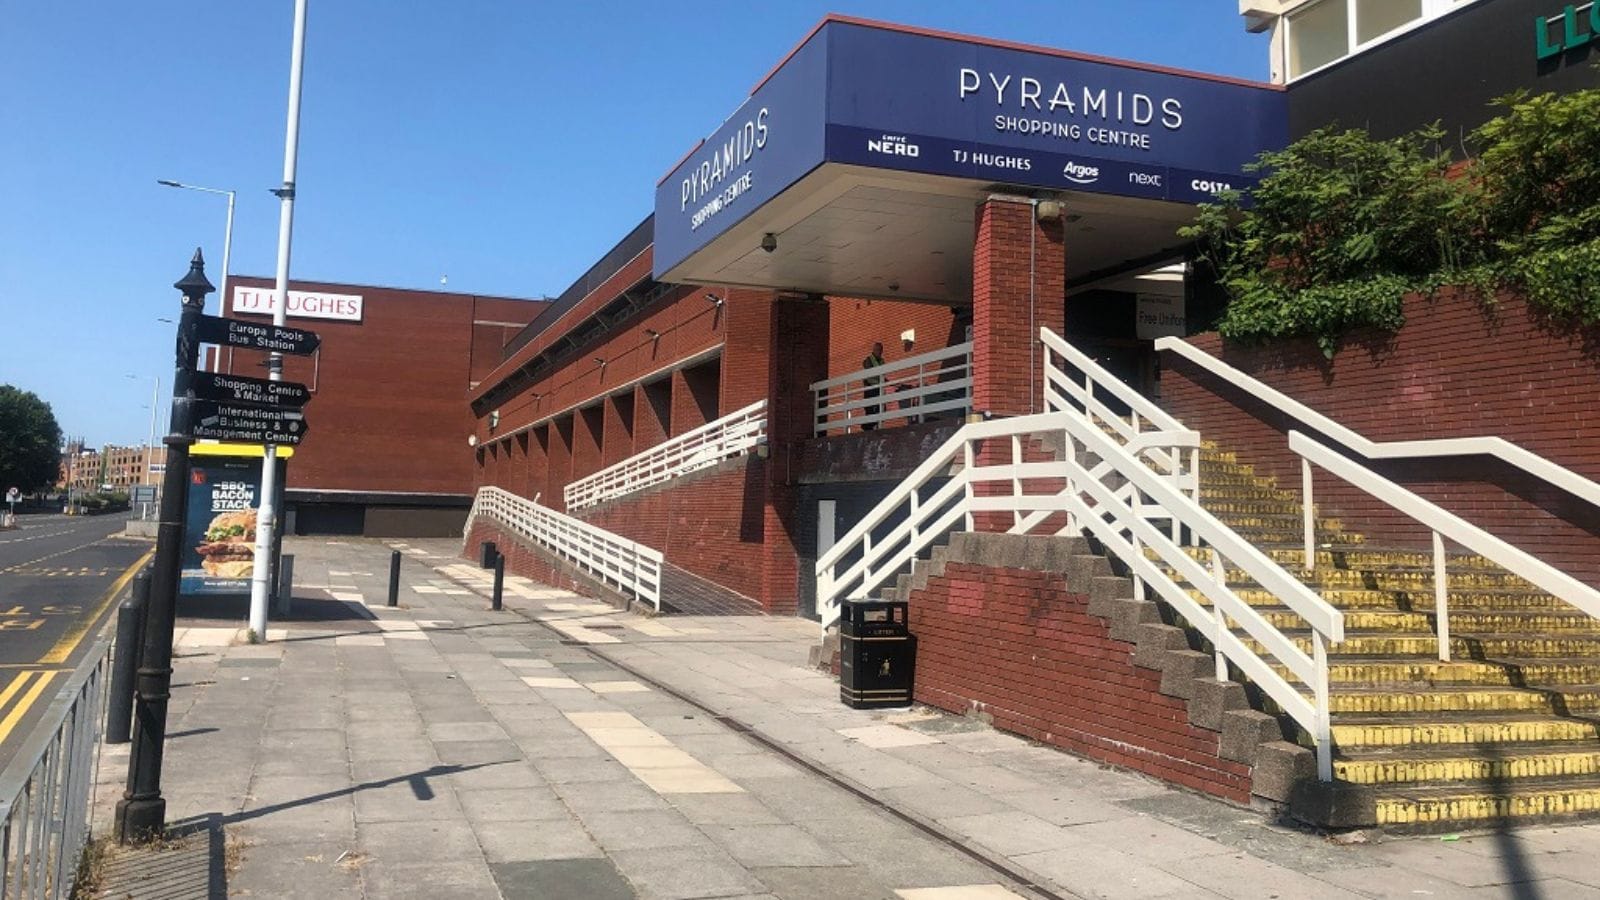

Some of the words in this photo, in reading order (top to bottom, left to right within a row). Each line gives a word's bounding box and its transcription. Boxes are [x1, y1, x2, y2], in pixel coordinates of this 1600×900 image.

[959, 68, 1183, 130] PYRAMIDS
[995, 115, 1081, 140] SHOPPING
[1087, 127, 1151, 150] CENTRE
[868, 139, 919, 158] NERO
[681, 107, 768, 212] PYRAMIDS
[953, 150, 968, 163] TJ
[972, 152, 1031, 171] HUGHES
[1063, 161, 1099, 178] Argos
[1128, 172, 1162, 187] next
[1191, 179, 1230, 193] COSTA
[691, 194, 723, 230] SHOPPING
[724, 170, 753, 206] CENTRE
[240, 292, 259, 312] TJ
[229, 322, 267, 337] Europa
[274, 328, 304, 342] Pools
[229, 333, 249, 345] Bus
[257, 337, 295, 351] Station
[214, 376, 262, 393] Shopping
[268, 384, 303, 397] Centre
[243, 390, 280, 404] Market
[218, 406, 284, 420] International
[219, 417, 268, 431] Business
[193, 425, 262, 441] Management
[264, 430, 299, 443] Centre
[212, 490, 254, 500] BACON
[212, 500, 251, 509] STACK
